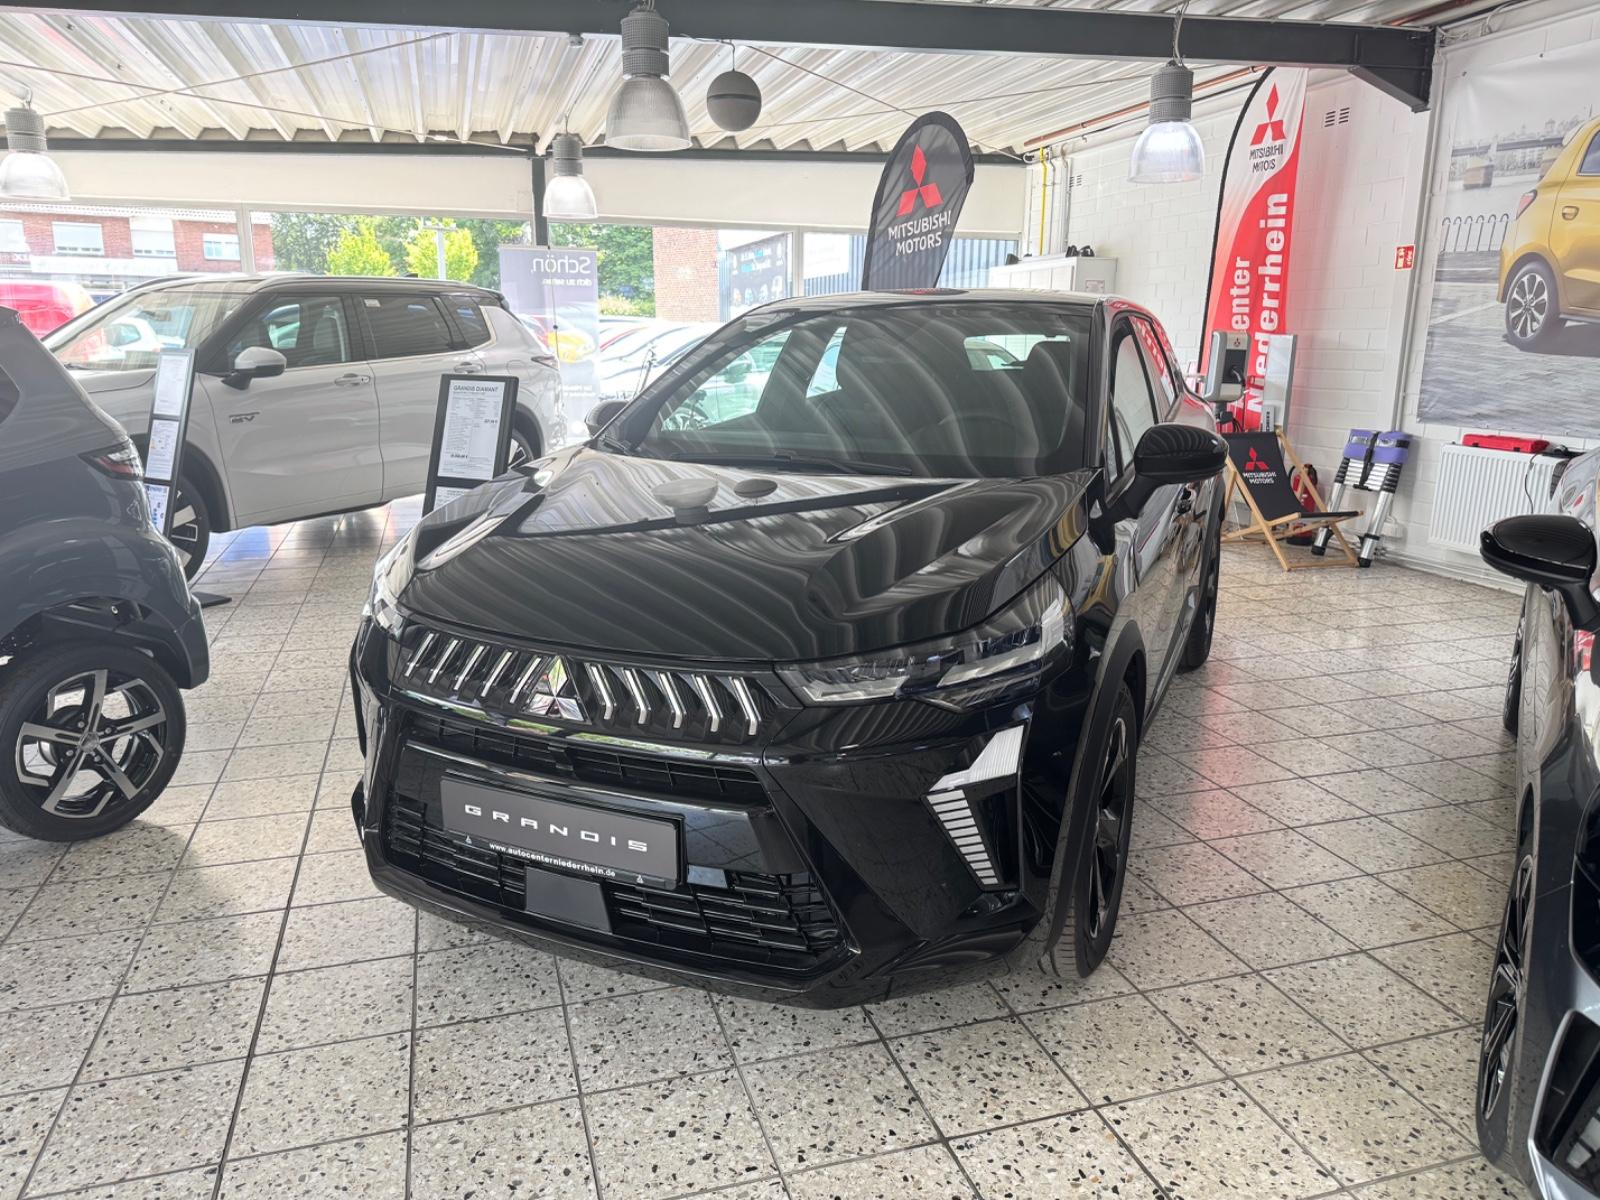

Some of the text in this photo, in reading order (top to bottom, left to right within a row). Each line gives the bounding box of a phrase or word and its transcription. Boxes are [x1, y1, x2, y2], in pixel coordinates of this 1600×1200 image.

[888, 210, 951, 240] MITSUBISHI
[895, 232, 942, 256] MOTORS
[1230, 256, 1250, 330] enter
[464, 804, 648, 852] GRANDIS
[489, 843, 616, 877] www.autocenterniederrhein.de
